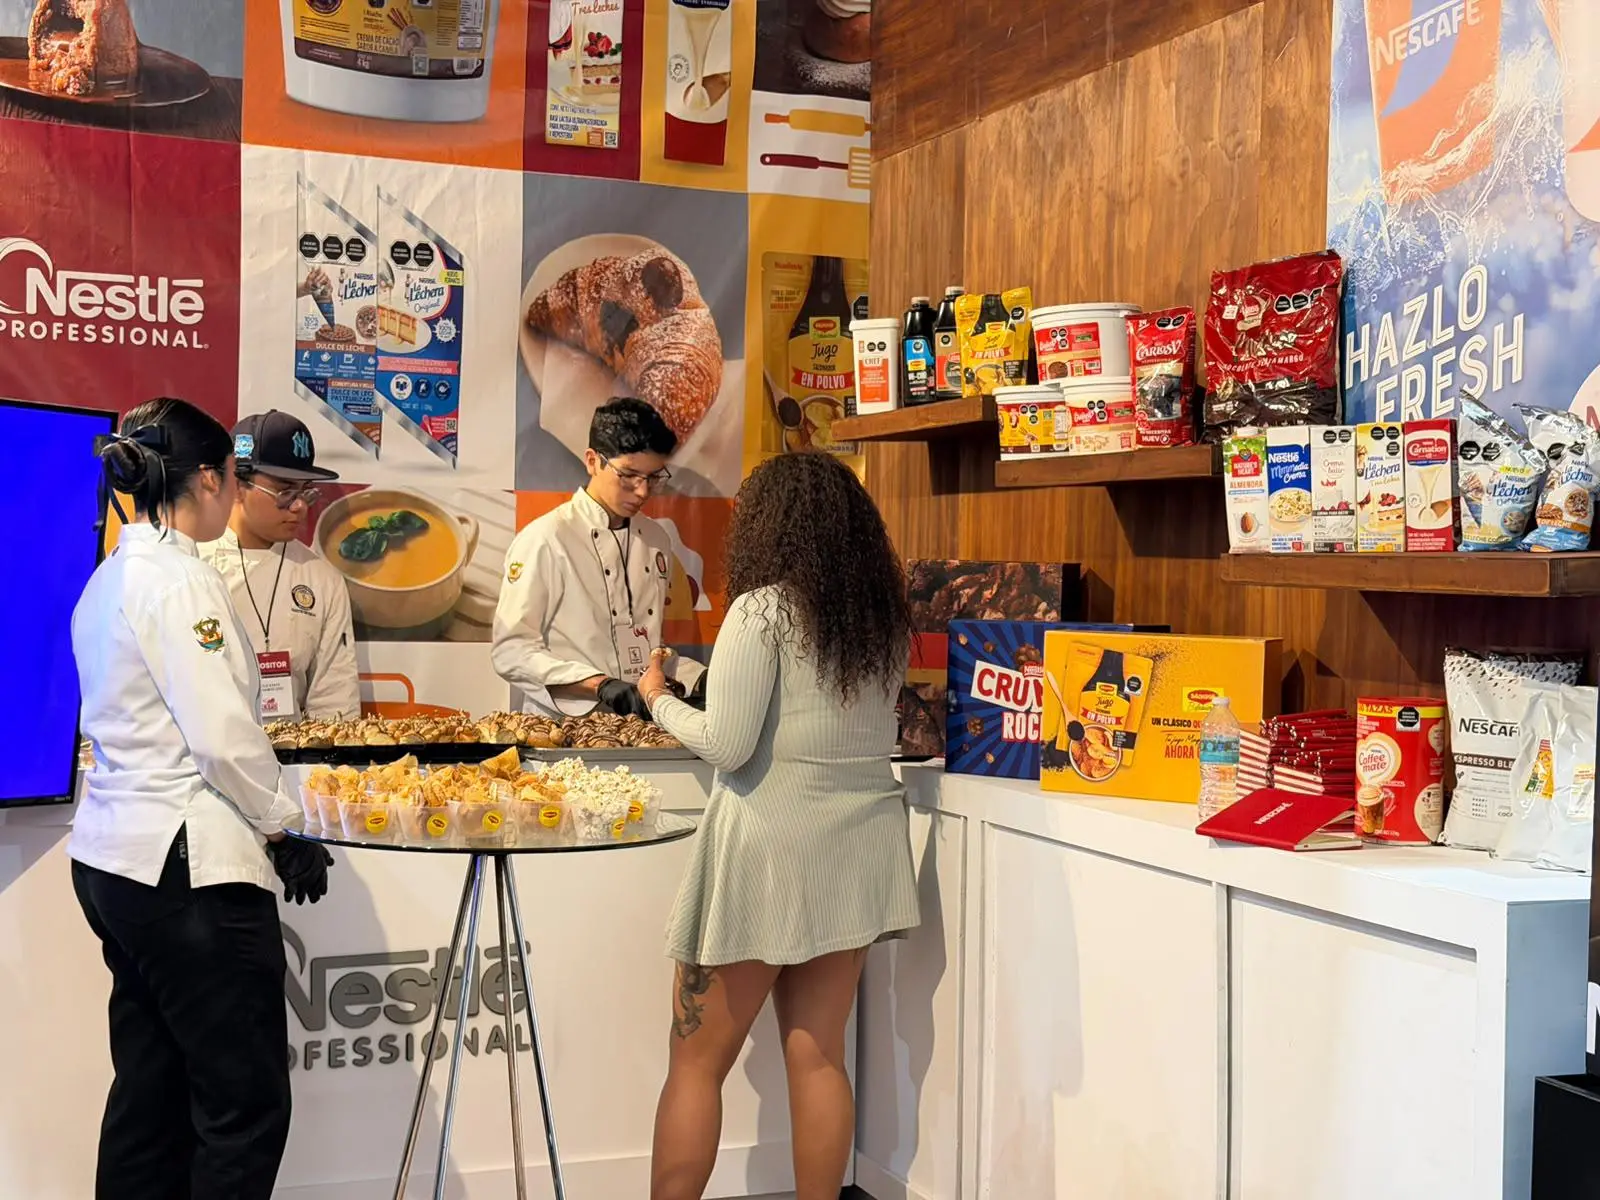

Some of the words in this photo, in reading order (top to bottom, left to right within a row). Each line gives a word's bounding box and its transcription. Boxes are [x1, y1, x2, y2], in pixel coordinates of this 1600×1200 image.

[1345, 263, 1488, 390] HAZLO
[315, 343, 335, 351] DULCE
[811, 343, 838, 362] Jugo
[1375, 313, 1525, 422] FRESH
[816, 374, 846, 389] POLVO
[1268, 451, 1300, 463] Nestlé
[1409, 443, 1448, 457] Carnation
[1364, 463, 1401, 480] Lechera
[1003, 711, 1043, 741] ROC
[1152, 718, 1161, 726] UN
[1162, 717, 1192, 728] CLÁSICO
[1459, 717, 1520, 738] NESCAF
[1164, 745, 1195, 759] AHORA
[1359, 752, 1386, 766] Coffee
[1363, 761, 1387, 773] mate
